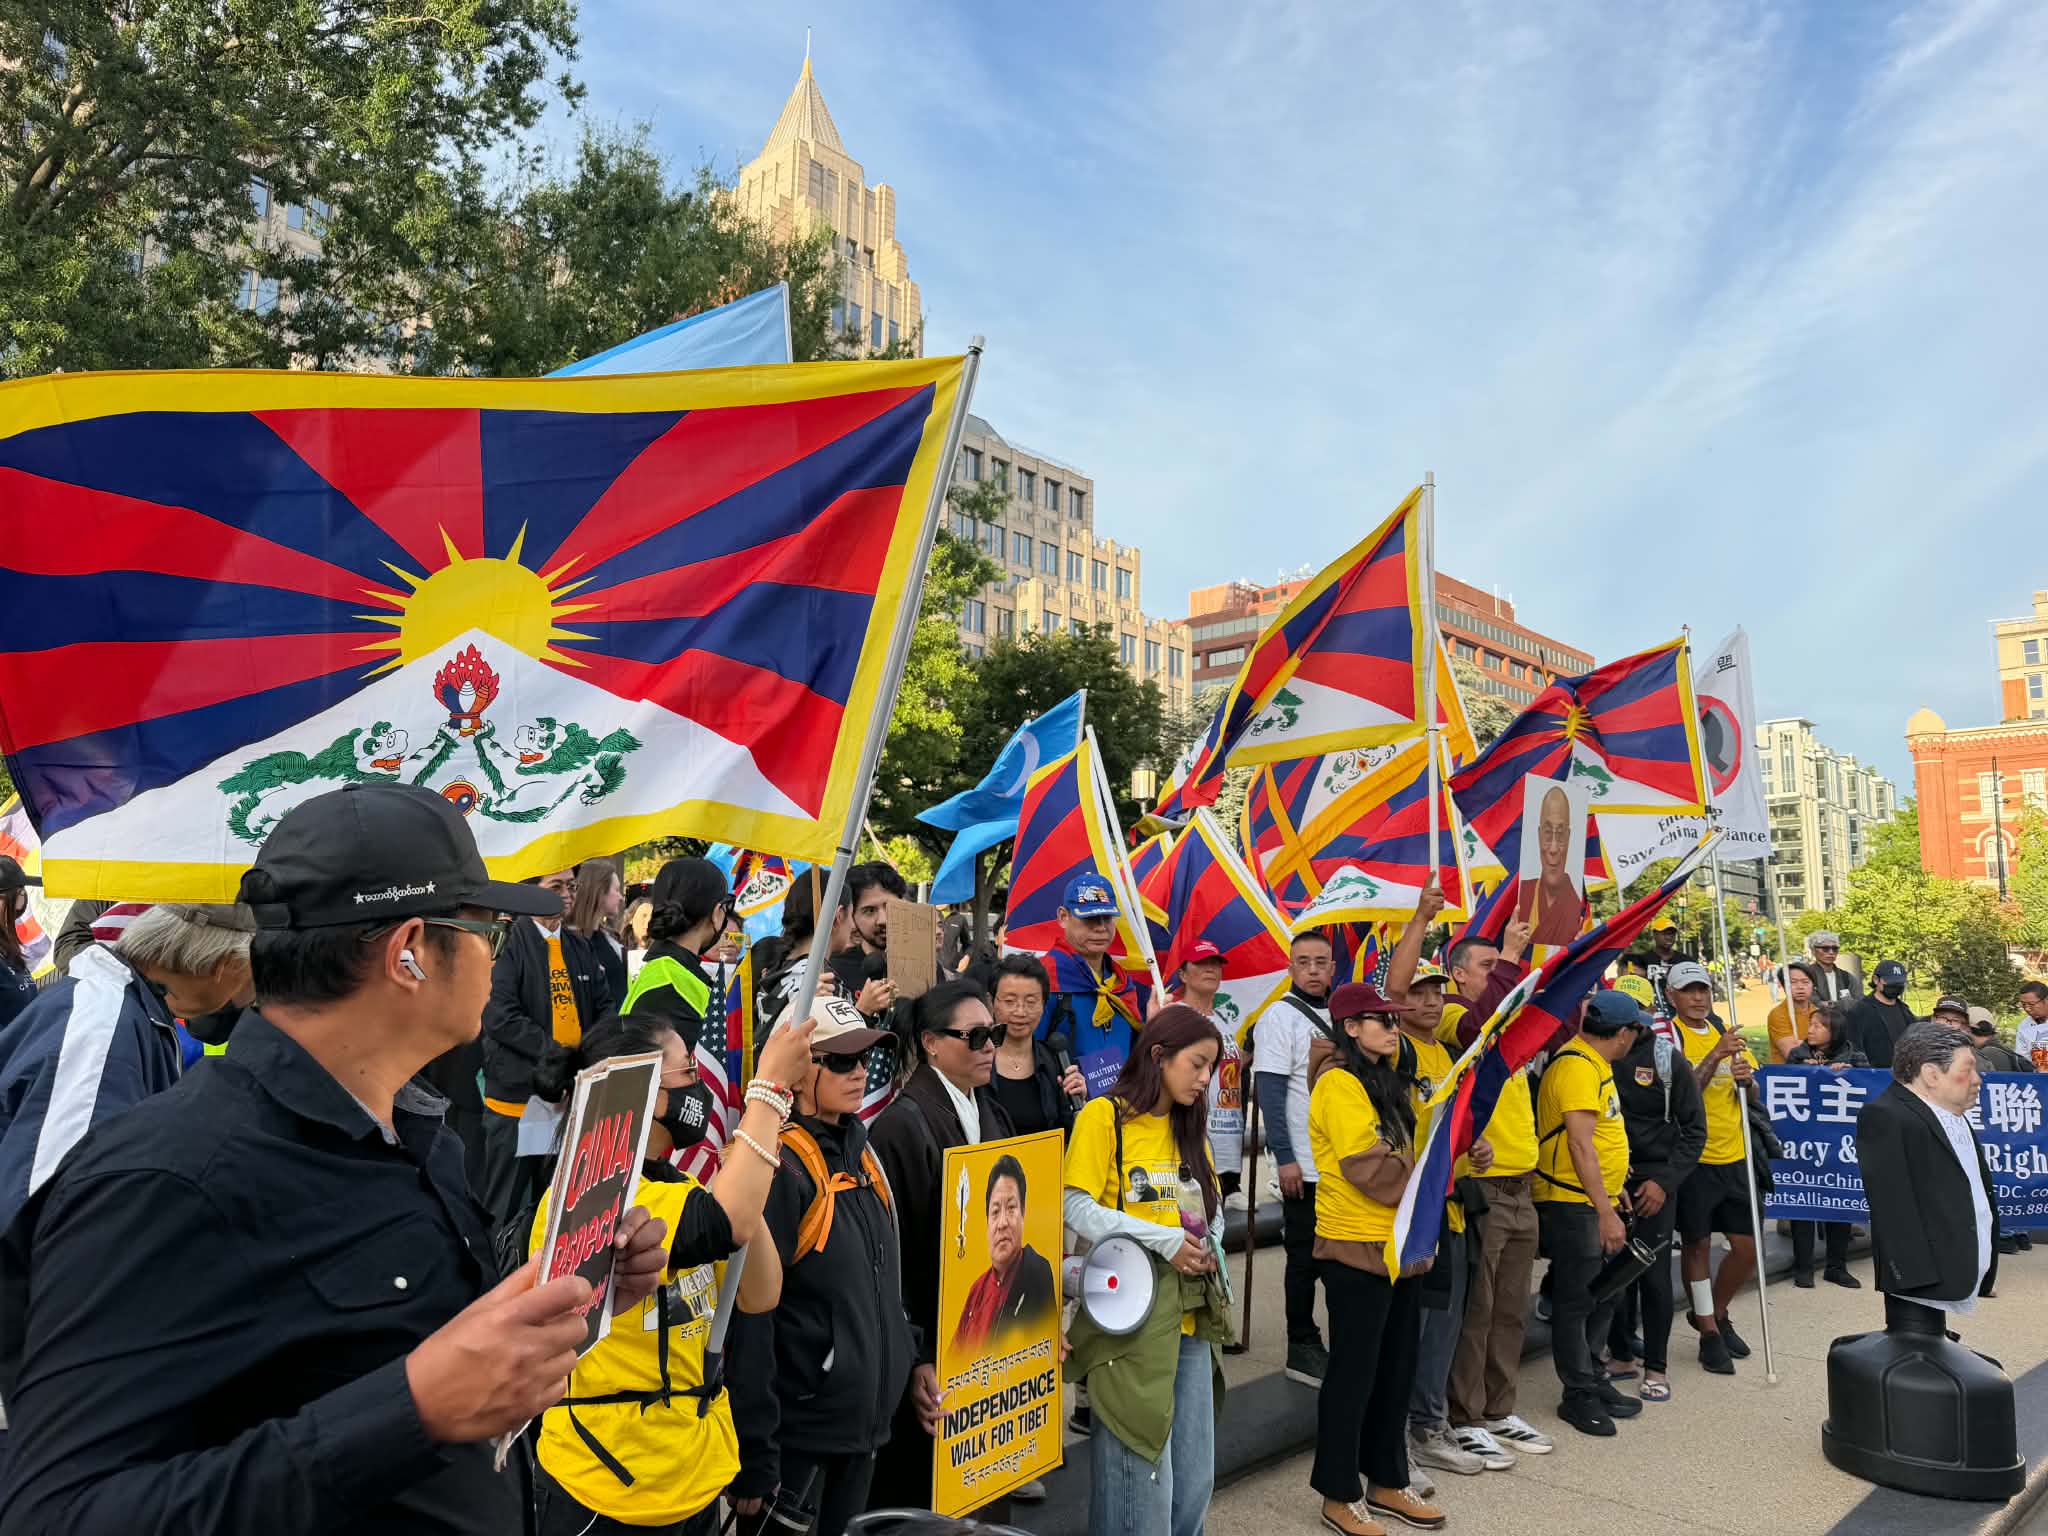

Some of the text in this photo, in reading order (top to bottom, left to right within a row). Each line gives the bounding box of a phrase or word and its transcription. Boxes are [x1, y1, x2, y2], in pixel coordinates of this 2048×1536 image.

[1659, 825, 1698, 847] China
[1725, 826, 1768, 843] iance
[685, 1095, 703, 1114] FREE
[679, 1107, 704, 1128] TIBET
[1779, 1139, 1831, 1168] acy
[1838, 1134, 1859, 1164] &
[1160, 1186, 1176, 1199] WAL
[943, 1368, 1056, 1440] INDEPENDENCE
[951, 1403, 1049, 1468] WALK FOR TIBET
